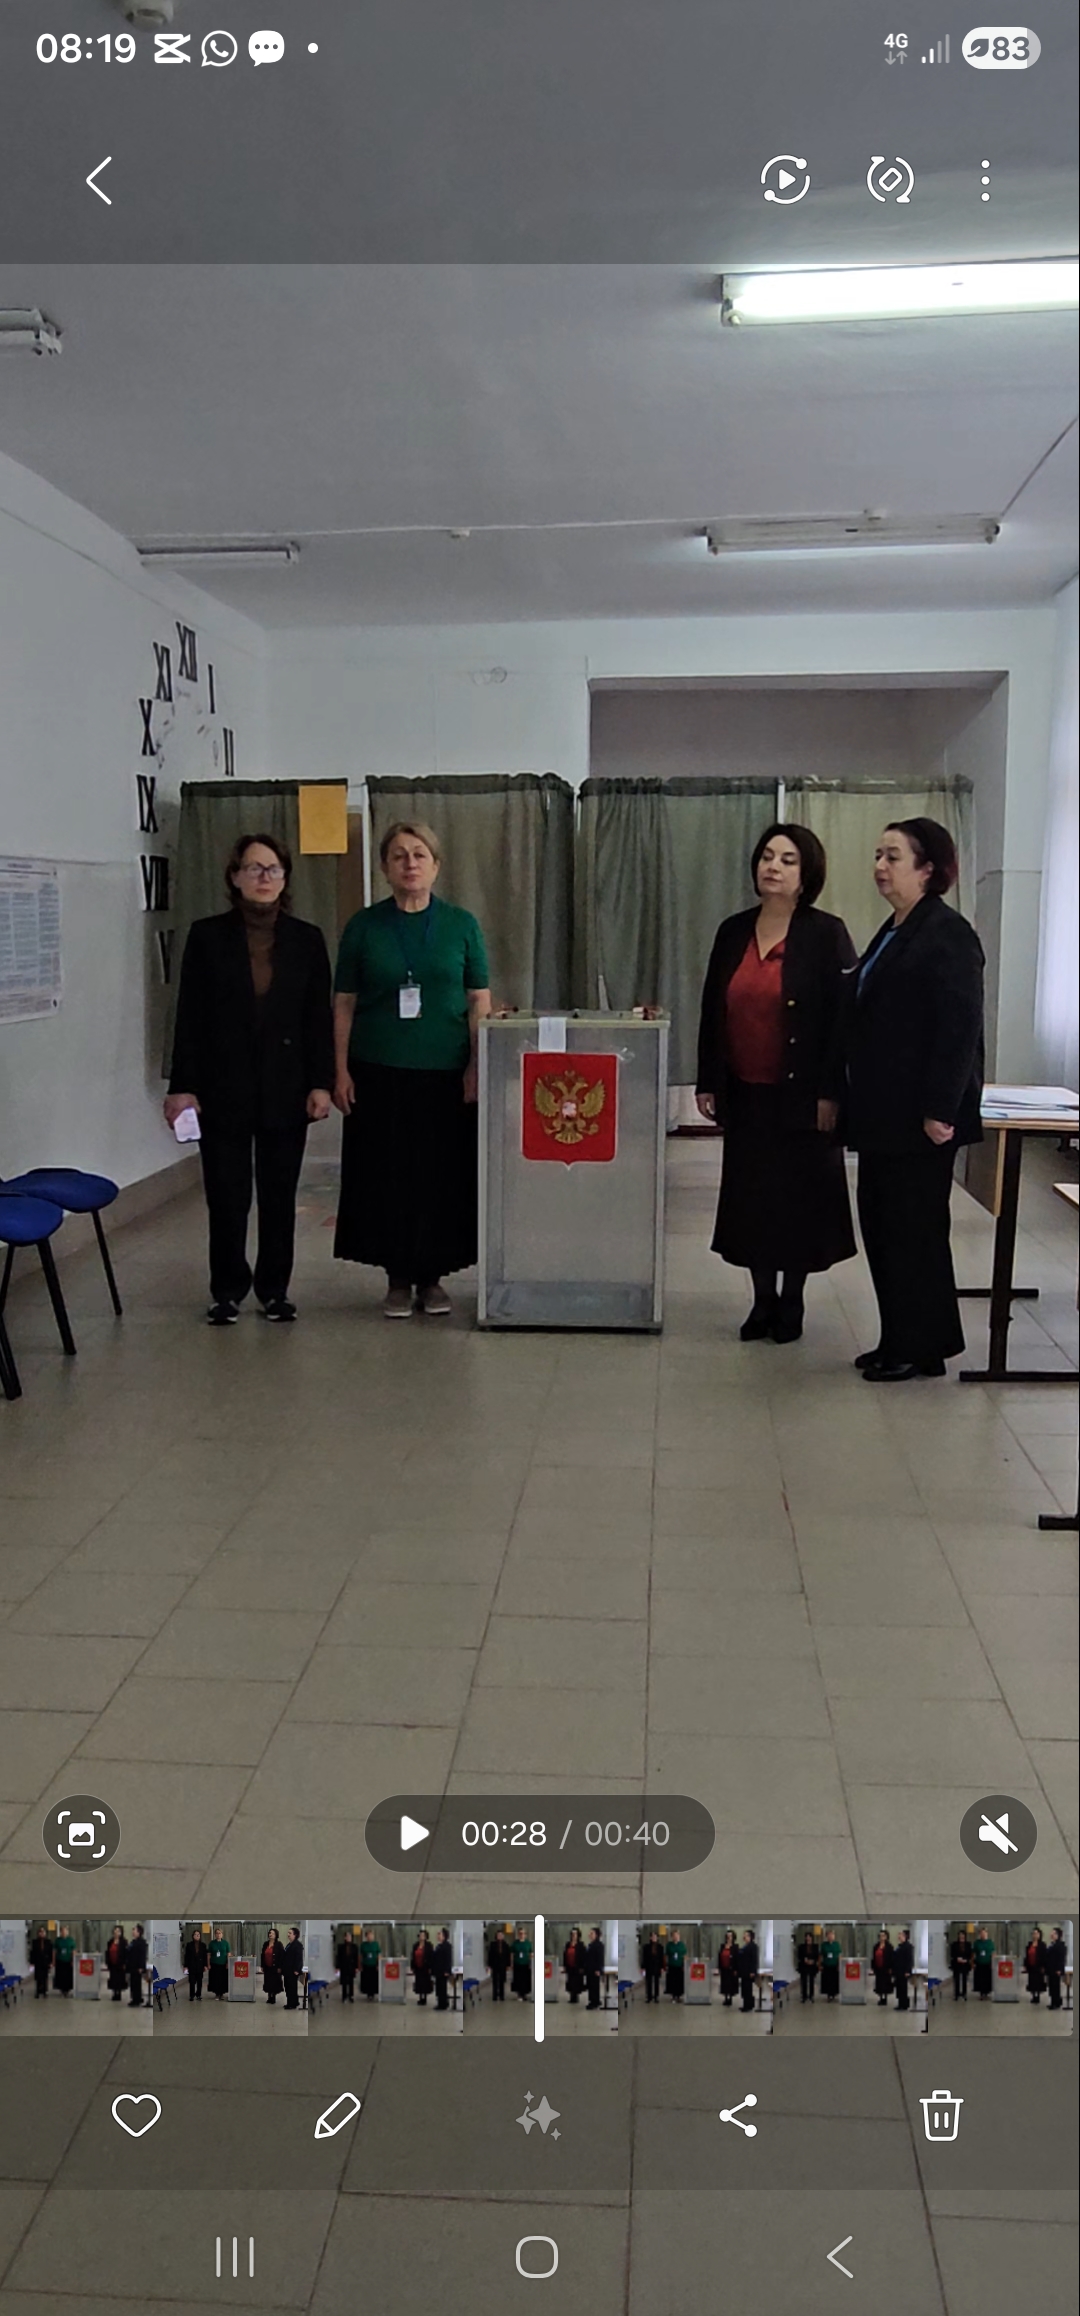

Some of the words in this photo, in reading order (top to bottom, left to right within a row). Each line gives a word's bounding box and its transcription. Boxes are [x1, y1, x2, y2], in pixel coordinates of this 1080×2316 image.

[153, 641, 173, 703] XI
[175, 621, 198, 683] XII
[138, 698, 157, 756] X
[222, 727, 235, 777] II
[136, 773, 159, 834] IX
